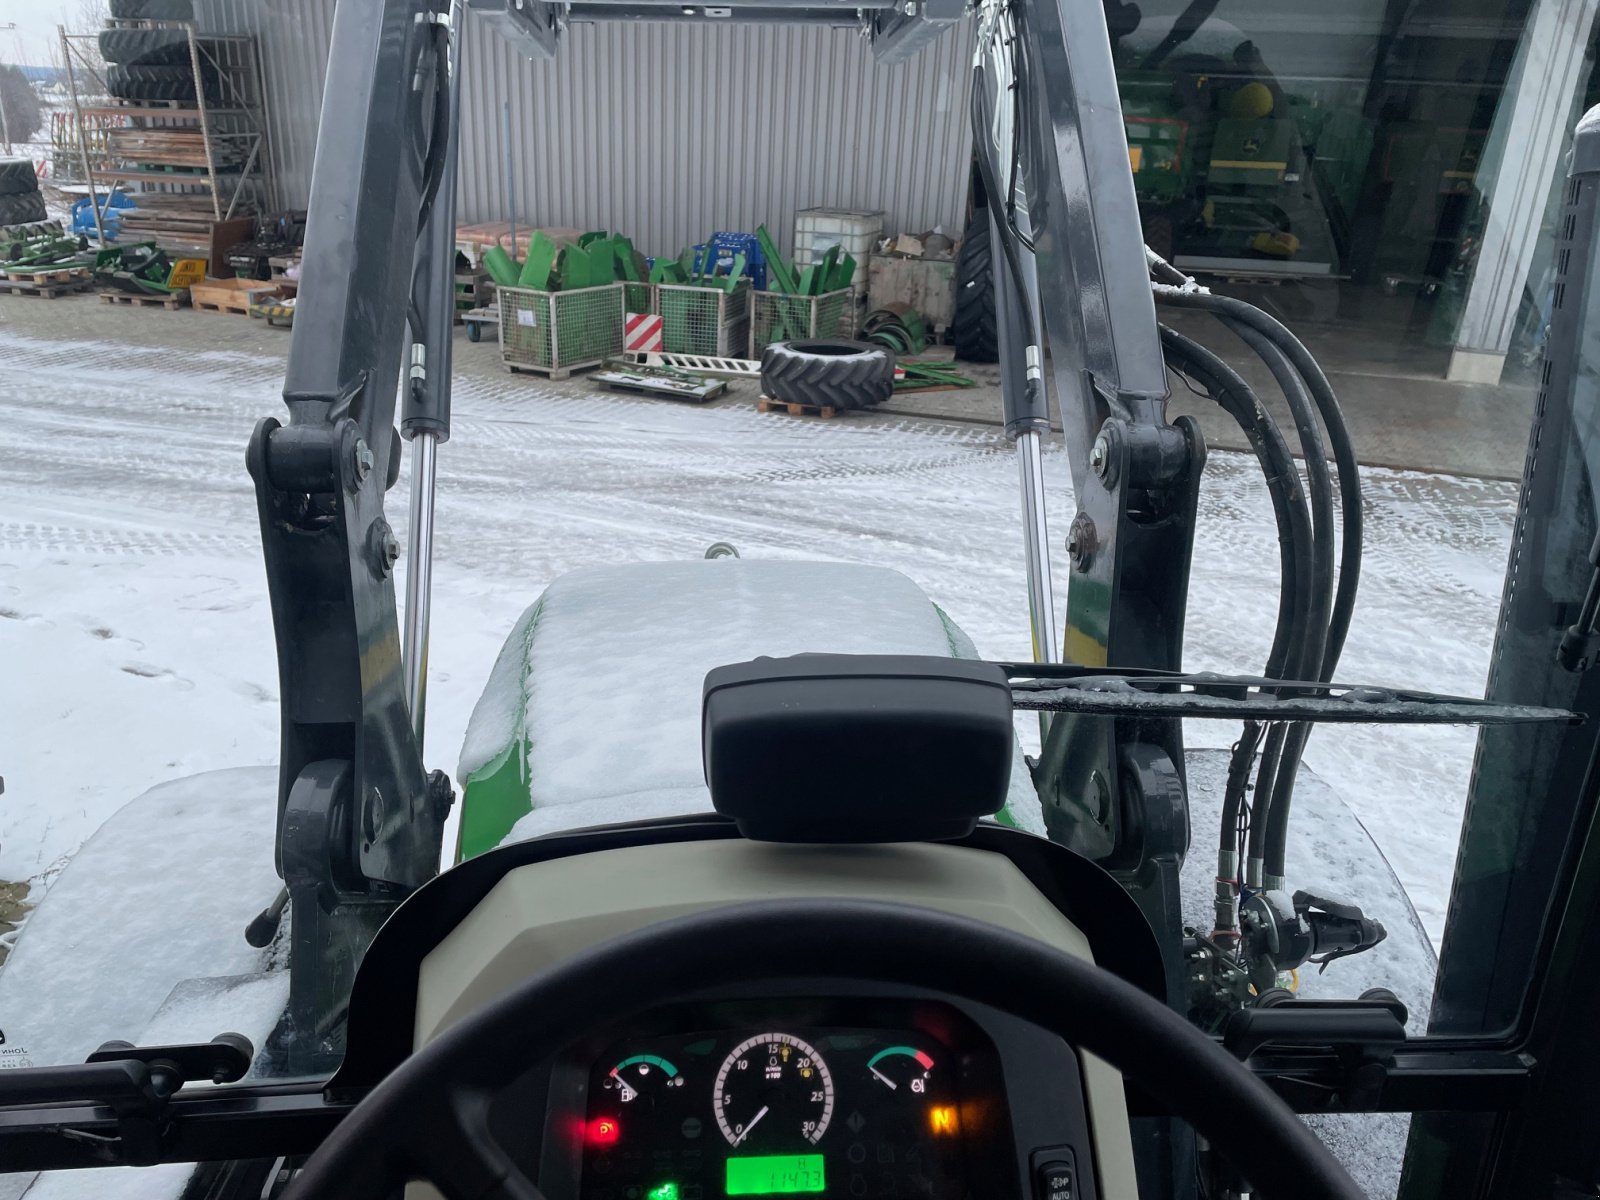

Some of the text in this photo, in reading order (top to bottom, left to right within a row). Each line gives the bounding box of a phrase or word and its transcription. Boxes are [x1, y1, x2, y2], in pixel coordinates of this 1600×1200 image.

[768, 1044, 778, 1054] 15
[737, 1060, 748, 1070] 10
[797, 1058, 810, 1068] 20
[724, 1094, 731, 1105] 5
[810, 1091, 824, 1102] 25
[735, 1123, 743, 1134] 0
[802, 1121, 815, 1132] 30
[1052, 1191, 1070, 1200] AUTO
